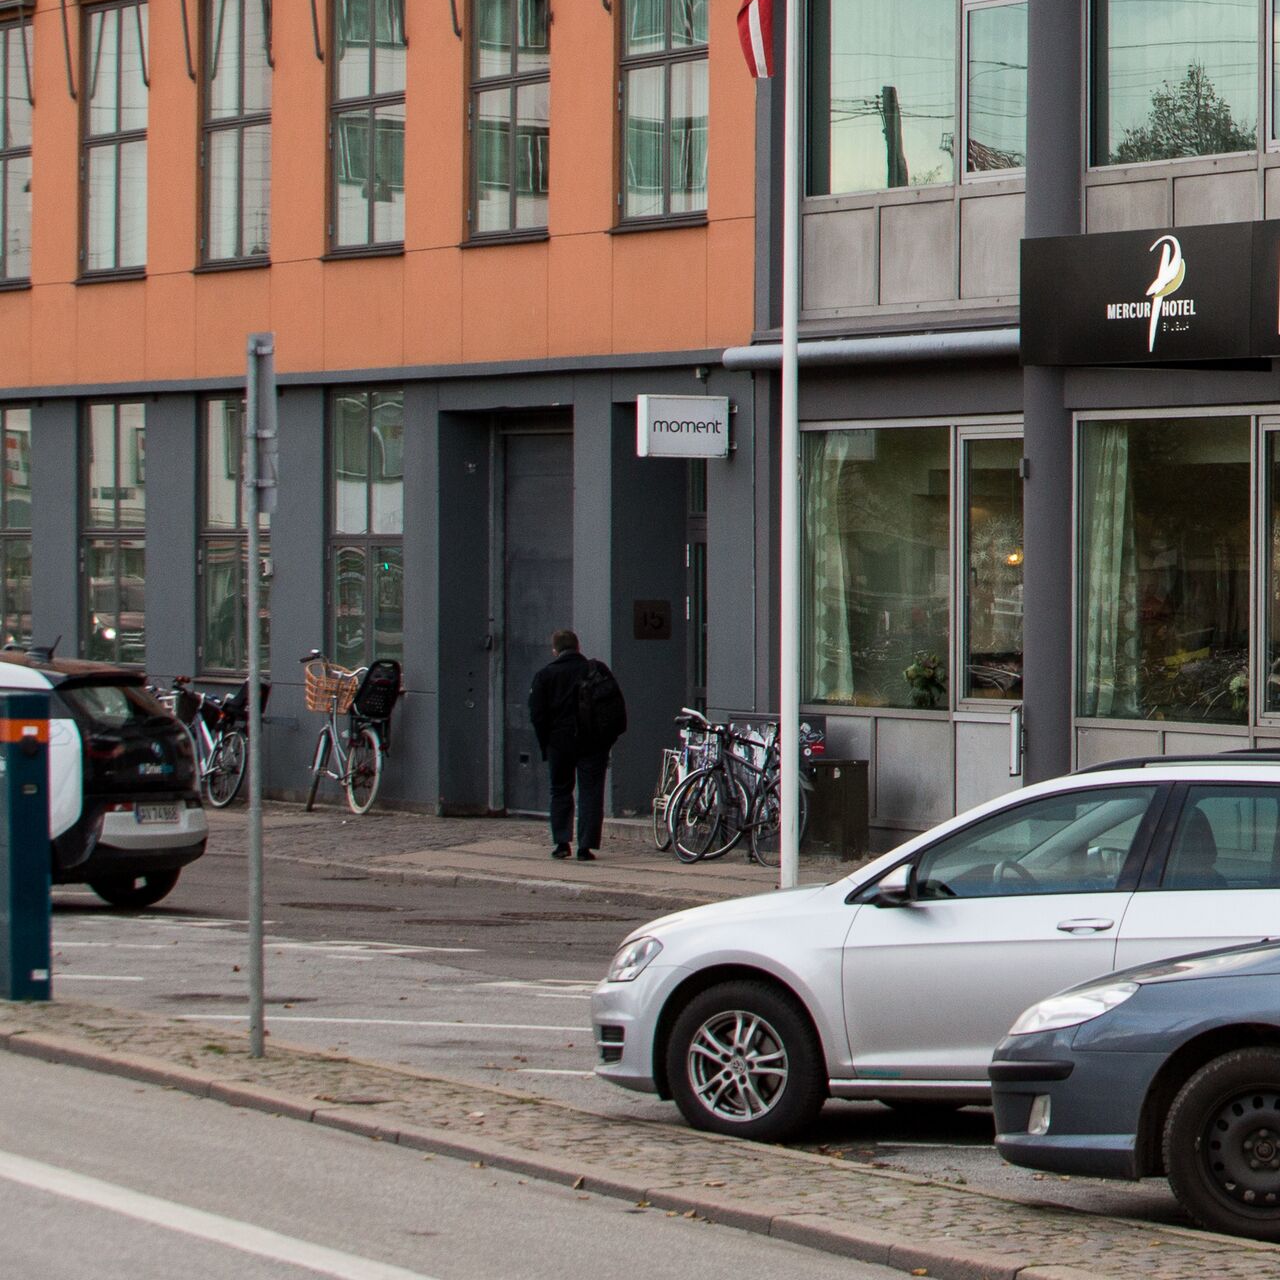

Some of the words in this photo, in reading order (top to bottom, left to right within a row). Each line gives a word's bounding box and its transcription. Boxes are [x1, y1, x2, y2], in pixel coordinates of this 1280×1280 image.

[1108, 302, 1150, 319] MERCUR
[1161, 299, 1196, 316] HOTEL
[654, 420, 722, 433] moment
